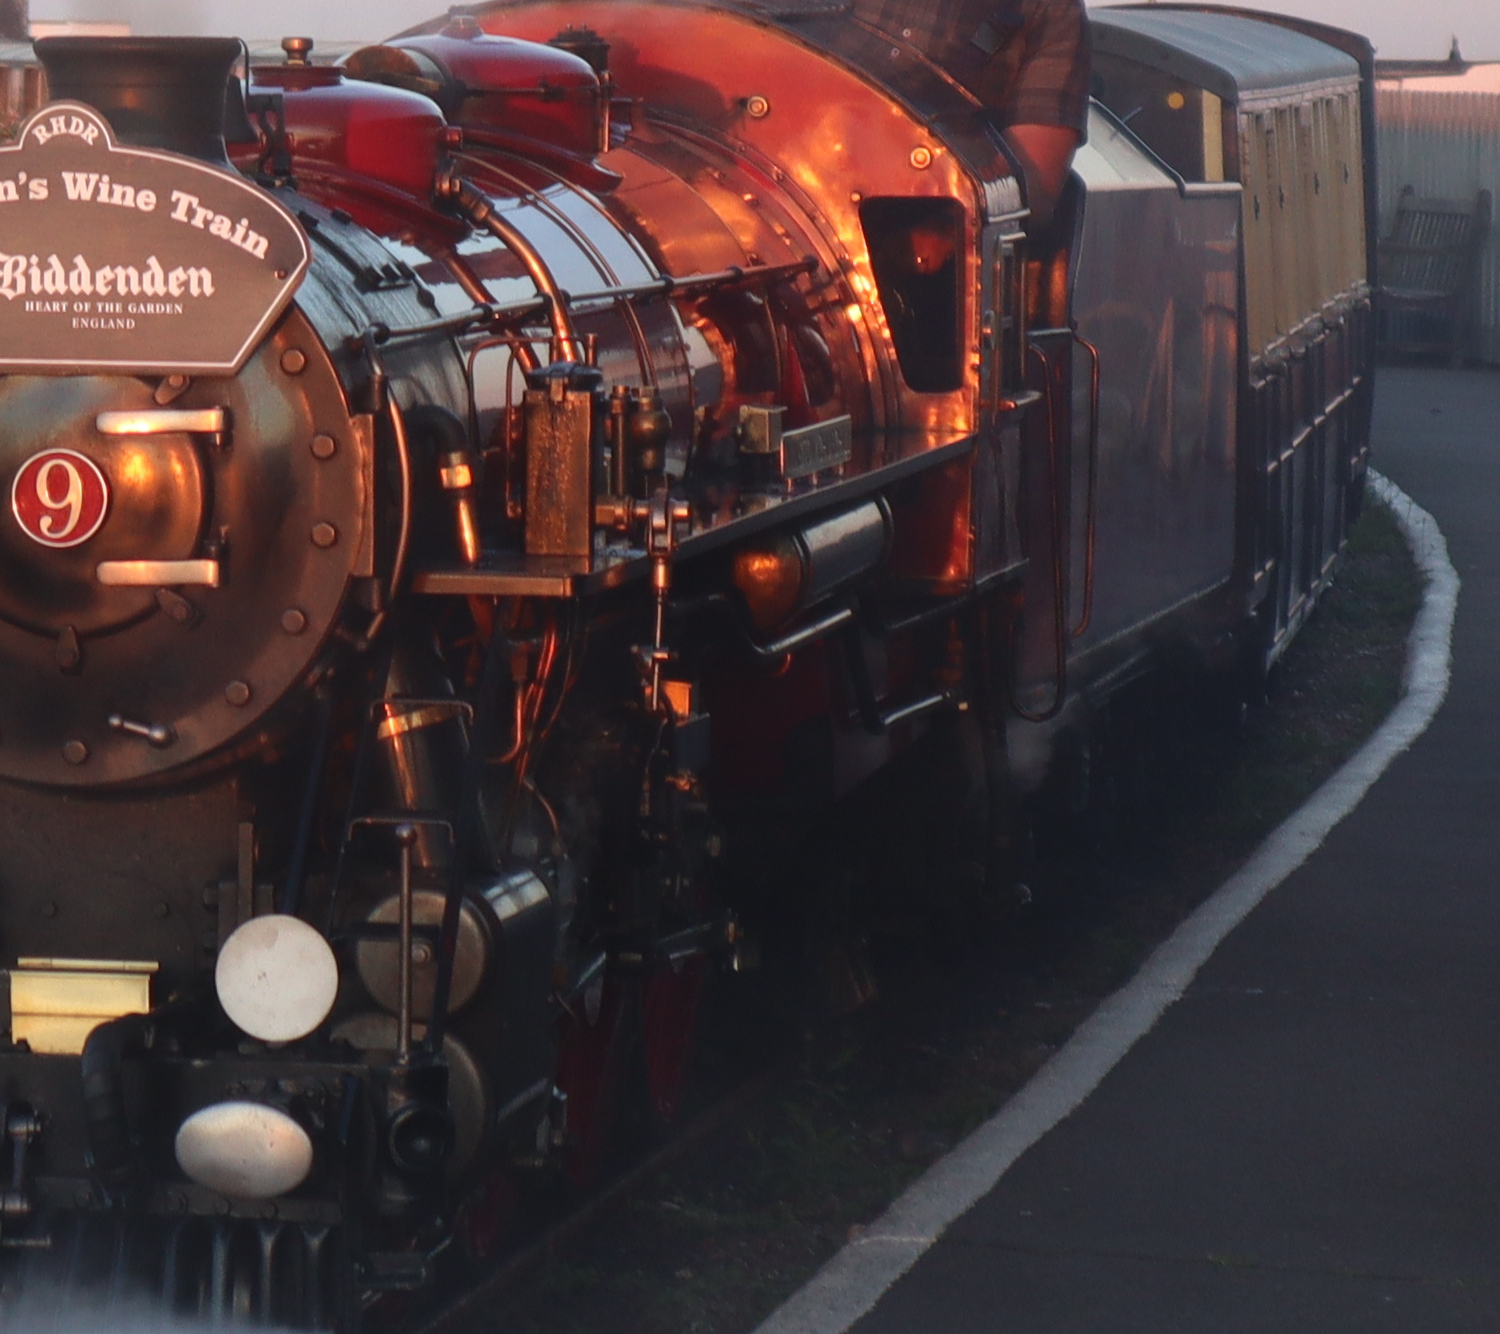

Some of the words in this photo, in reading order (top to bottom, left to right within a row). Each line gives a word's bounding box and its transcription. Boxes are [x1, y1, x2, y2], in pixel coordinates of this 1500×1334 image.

[31, 115, 99, 146] RHDR
[61, 171, 157, 212] Wine
[170, 189, 269, 260] Train
[24, 300, 69, 313] HEART
[72, 301, 92, 313] OF
[96, 301, 123, 314] THE
[127, 301, 184, 315] GARDEN
[71, 316, 136, 330] ENGLAND
[36, 458, 83, 539] 9
